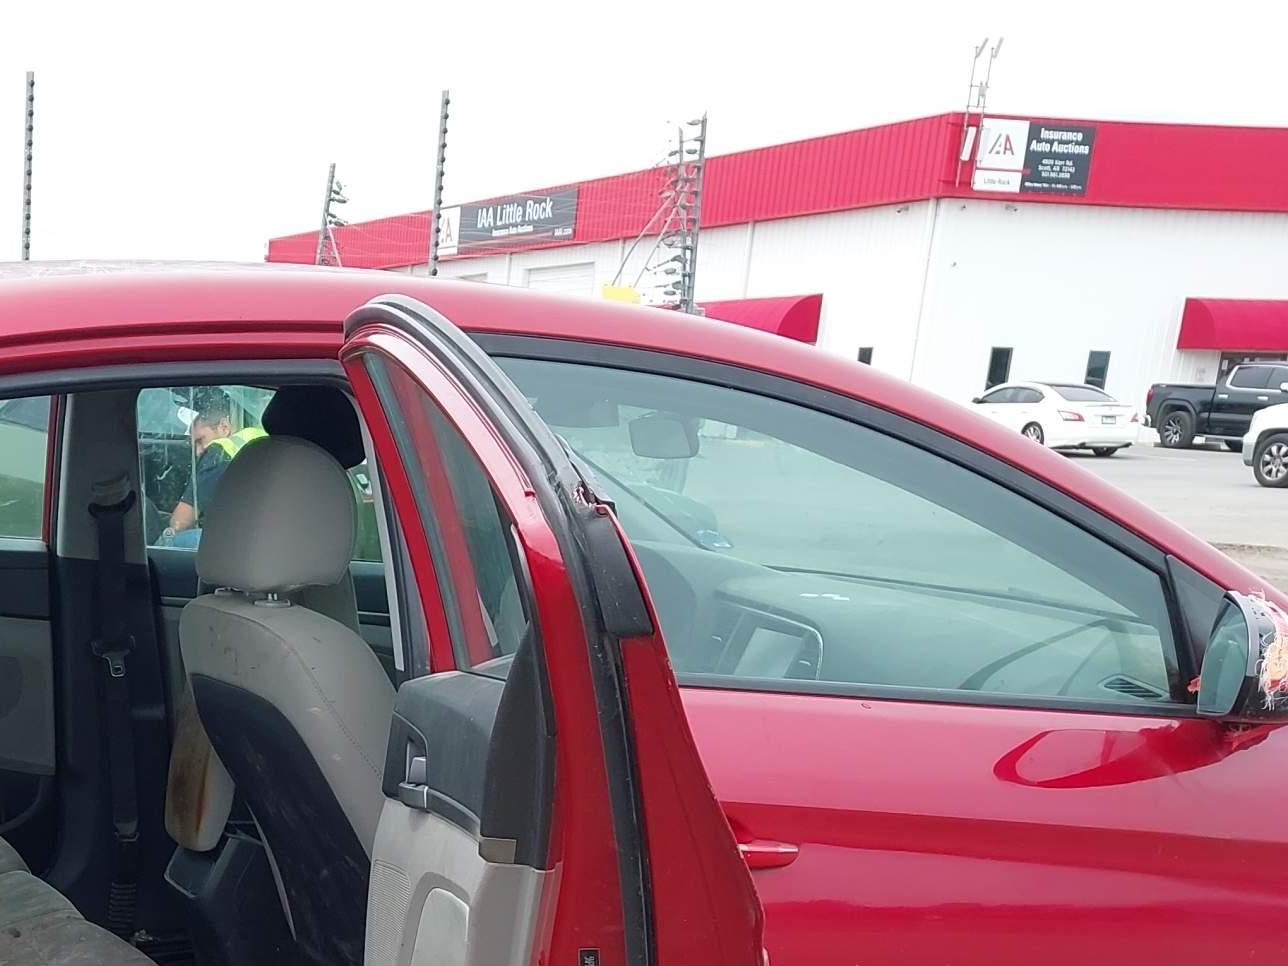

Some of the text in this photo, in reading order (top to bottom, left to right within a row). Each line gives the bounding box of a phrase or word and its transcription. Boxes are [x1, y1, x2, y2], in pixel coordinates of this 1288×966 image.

[1041, 128, 1083, 142] Insurance
[1030, 139, 1089, 155] Auto Auctions
[477, 197, 553, 229] IAA Little Rock
